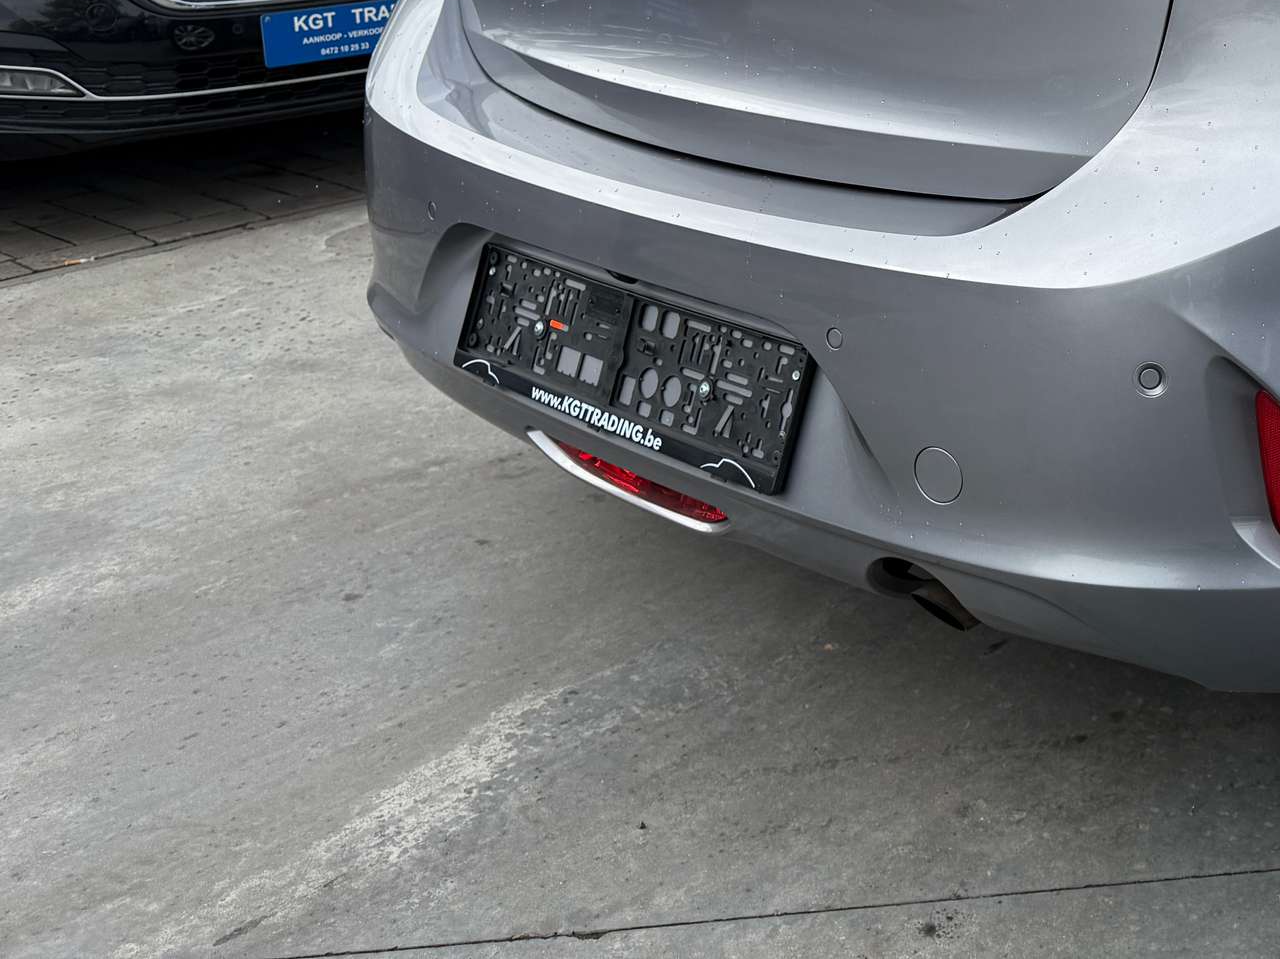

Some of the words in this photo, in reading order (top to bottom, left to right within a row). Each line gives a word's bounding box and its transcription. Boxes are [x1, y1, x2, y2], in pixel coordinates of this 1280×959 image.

[293, 12, 336, 33] KGT
[302, 32, 343, 45] AANKOOP
[531, 386, 663, 451] www.KGTTRADING.be
